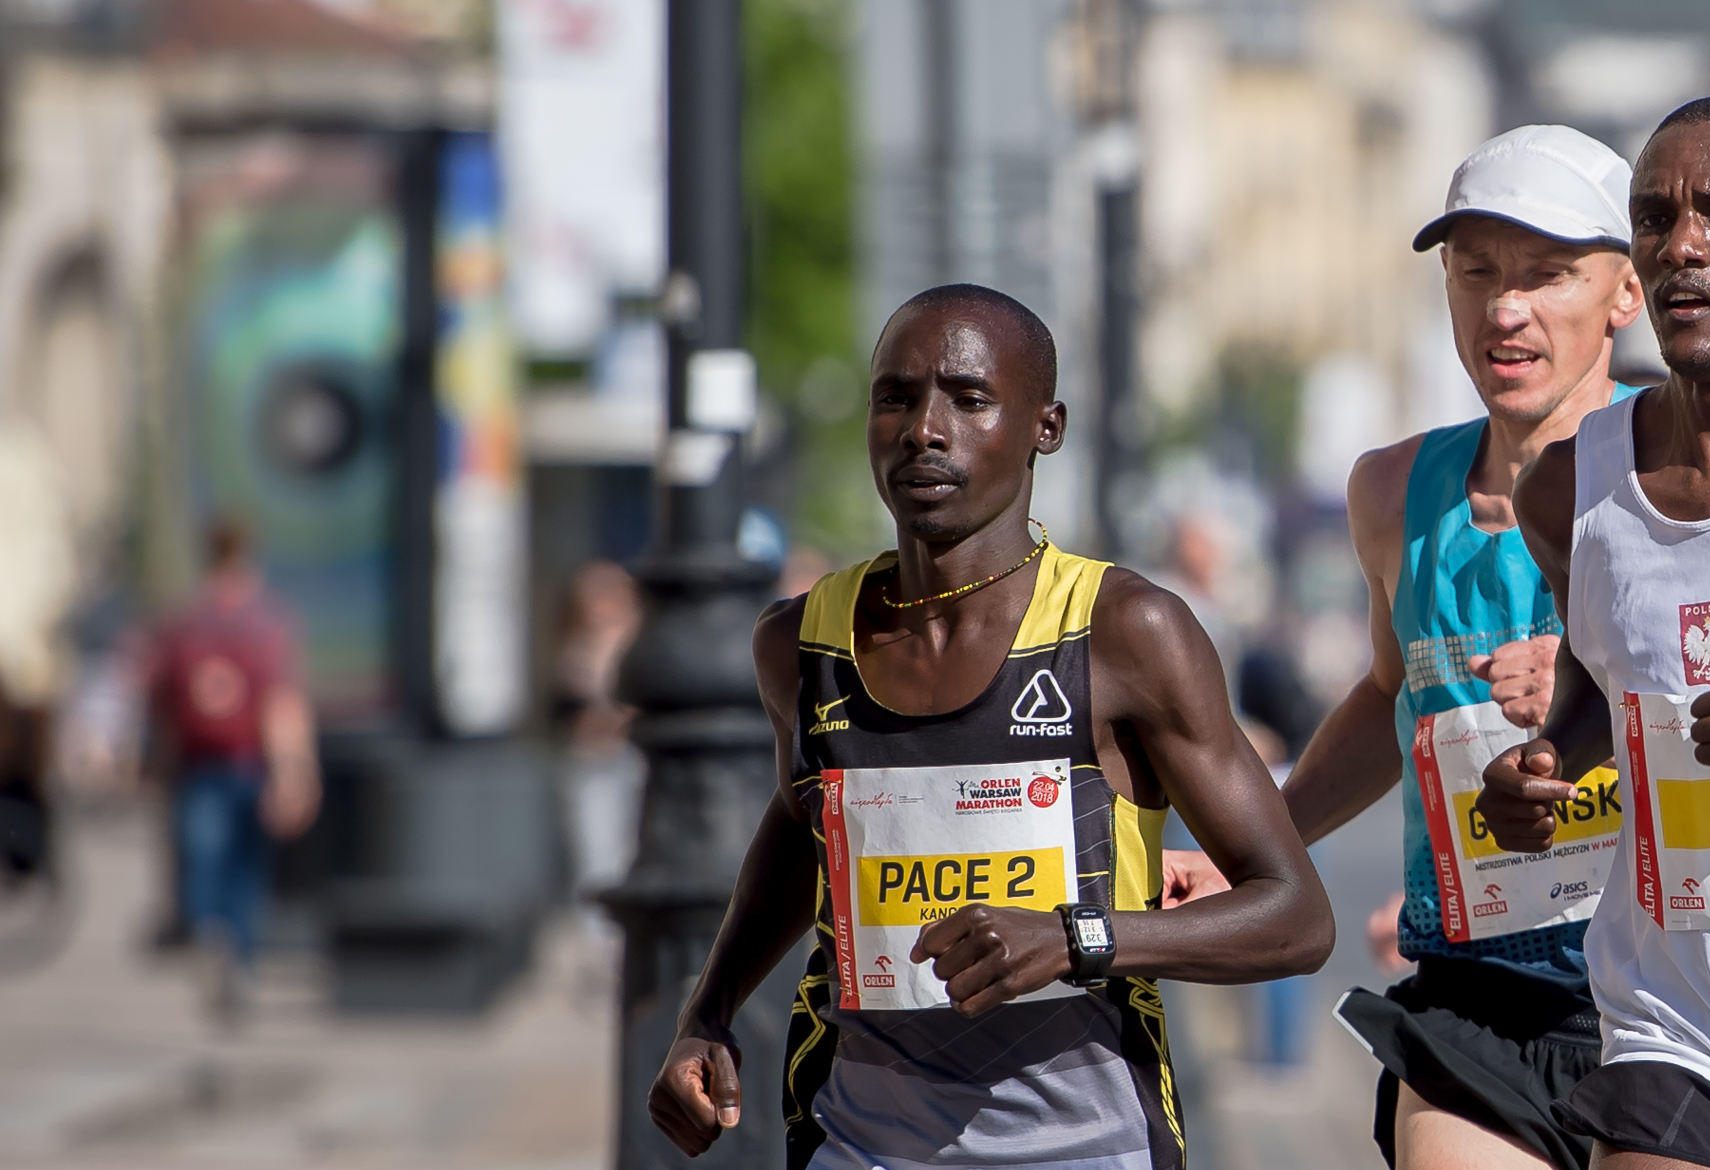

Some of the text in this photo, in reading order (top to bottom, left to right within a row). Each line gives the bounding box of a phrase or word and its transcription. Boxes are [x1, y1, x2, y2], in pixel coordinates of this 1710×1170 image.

[1009, 722, 1073, 737] run-fast
[980, 778, 1021, 789] ORLEN
[969, 787, 1022, 799] WARSAW
[1031, 790, 1054, 803] 2018
[955, 798, 1023, 810] MARATHON
[1475, 857, 1523, 872] MISTRZOSTWA
[1524, 851, 1551, 864] POLSKI
[1591, 842, 1600, 851] W
[1639, 836, 1652, 872] ELITE
[1438, 853, 1455, 887] ELITE
[879, 856, 1035, 903] PACE 2
[1563, 881, 1588, 894] asics
[1643, 881, 1656, 918] ELITA
[1671, 898, 1704, 909] ORLEN
[1447, 896, 1462, 930] ELITA
[1475, 902, 1506, 916] ORLEN
[838, 914, 850, 951] ELITE
[865, 976, 894, 987] ORLEN
